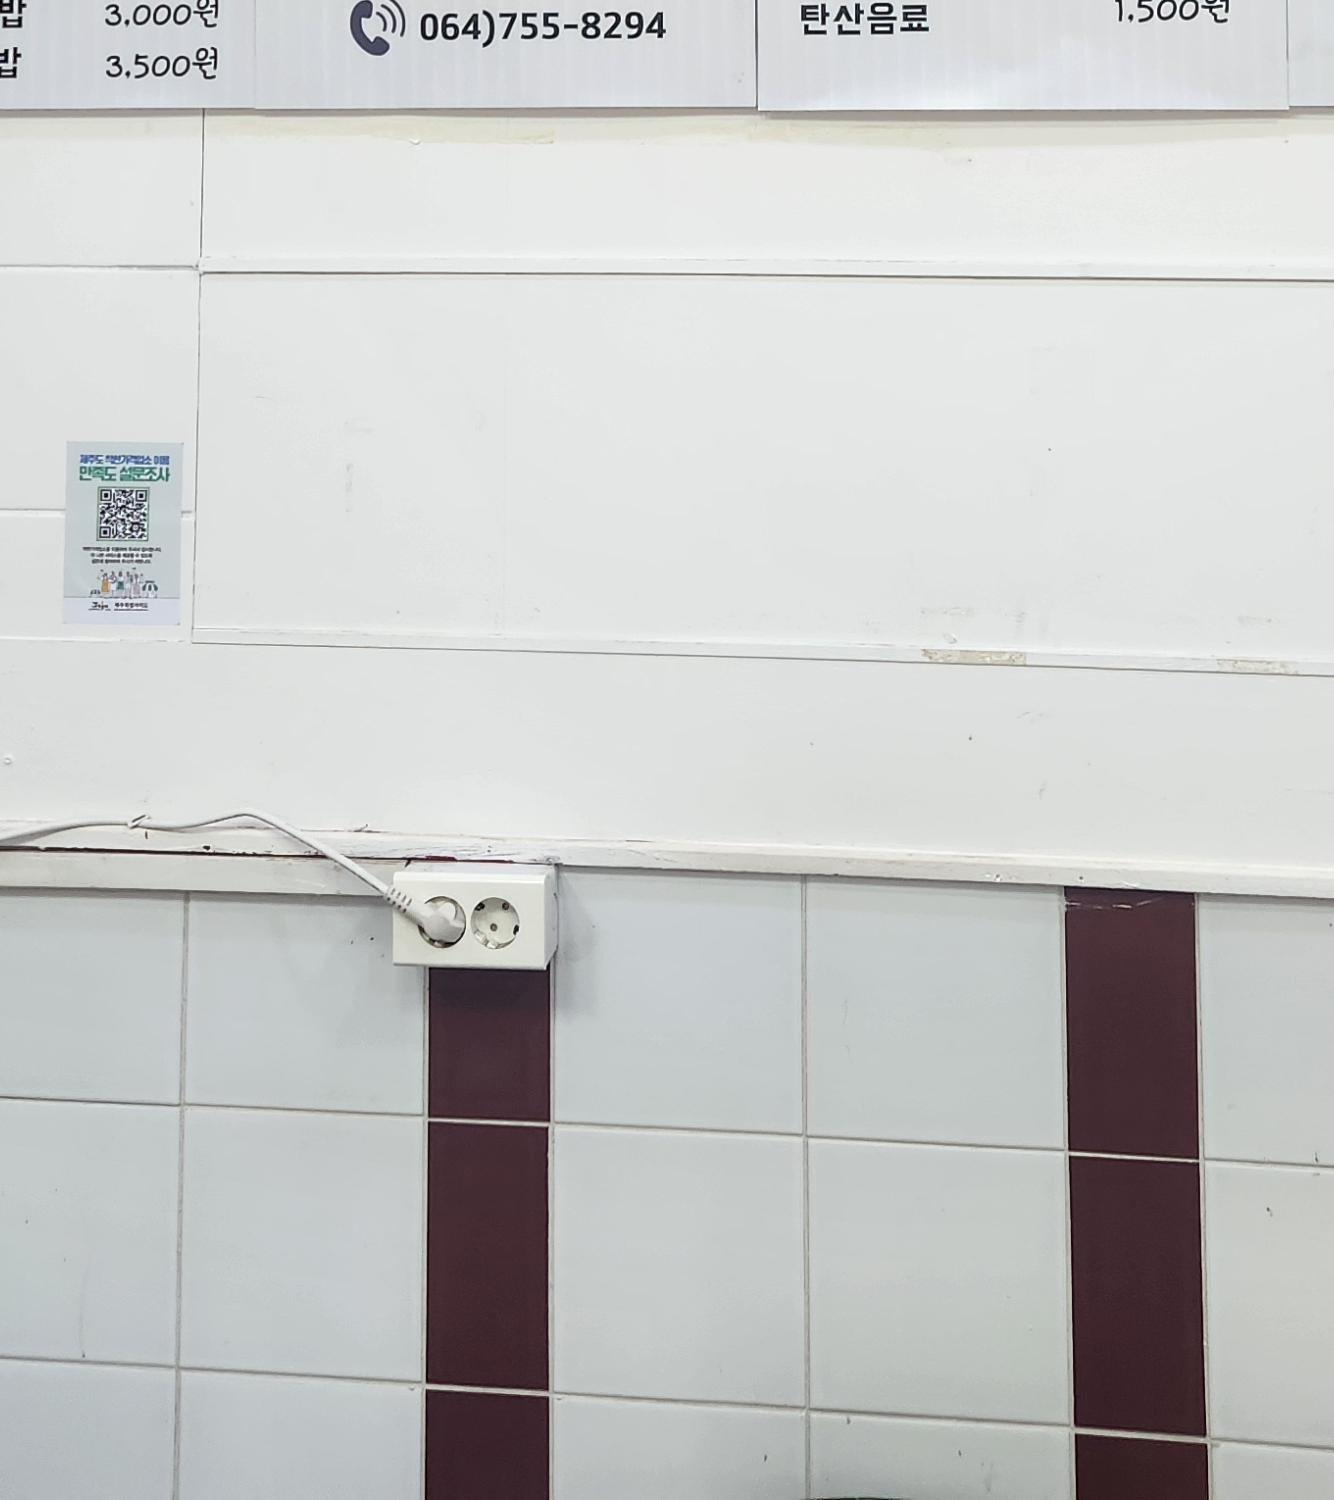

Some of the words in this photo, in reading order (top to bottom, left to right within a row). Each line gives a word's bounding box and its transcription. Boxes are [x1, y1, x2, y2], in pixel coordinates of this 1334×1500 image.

[420, 10, 666, 48] 064)755-8294
[801, 2, 929, 36] 탄산음료
[79, 466, 116, 481] 만족도
[120, 466, 170, 482] 설문조사
